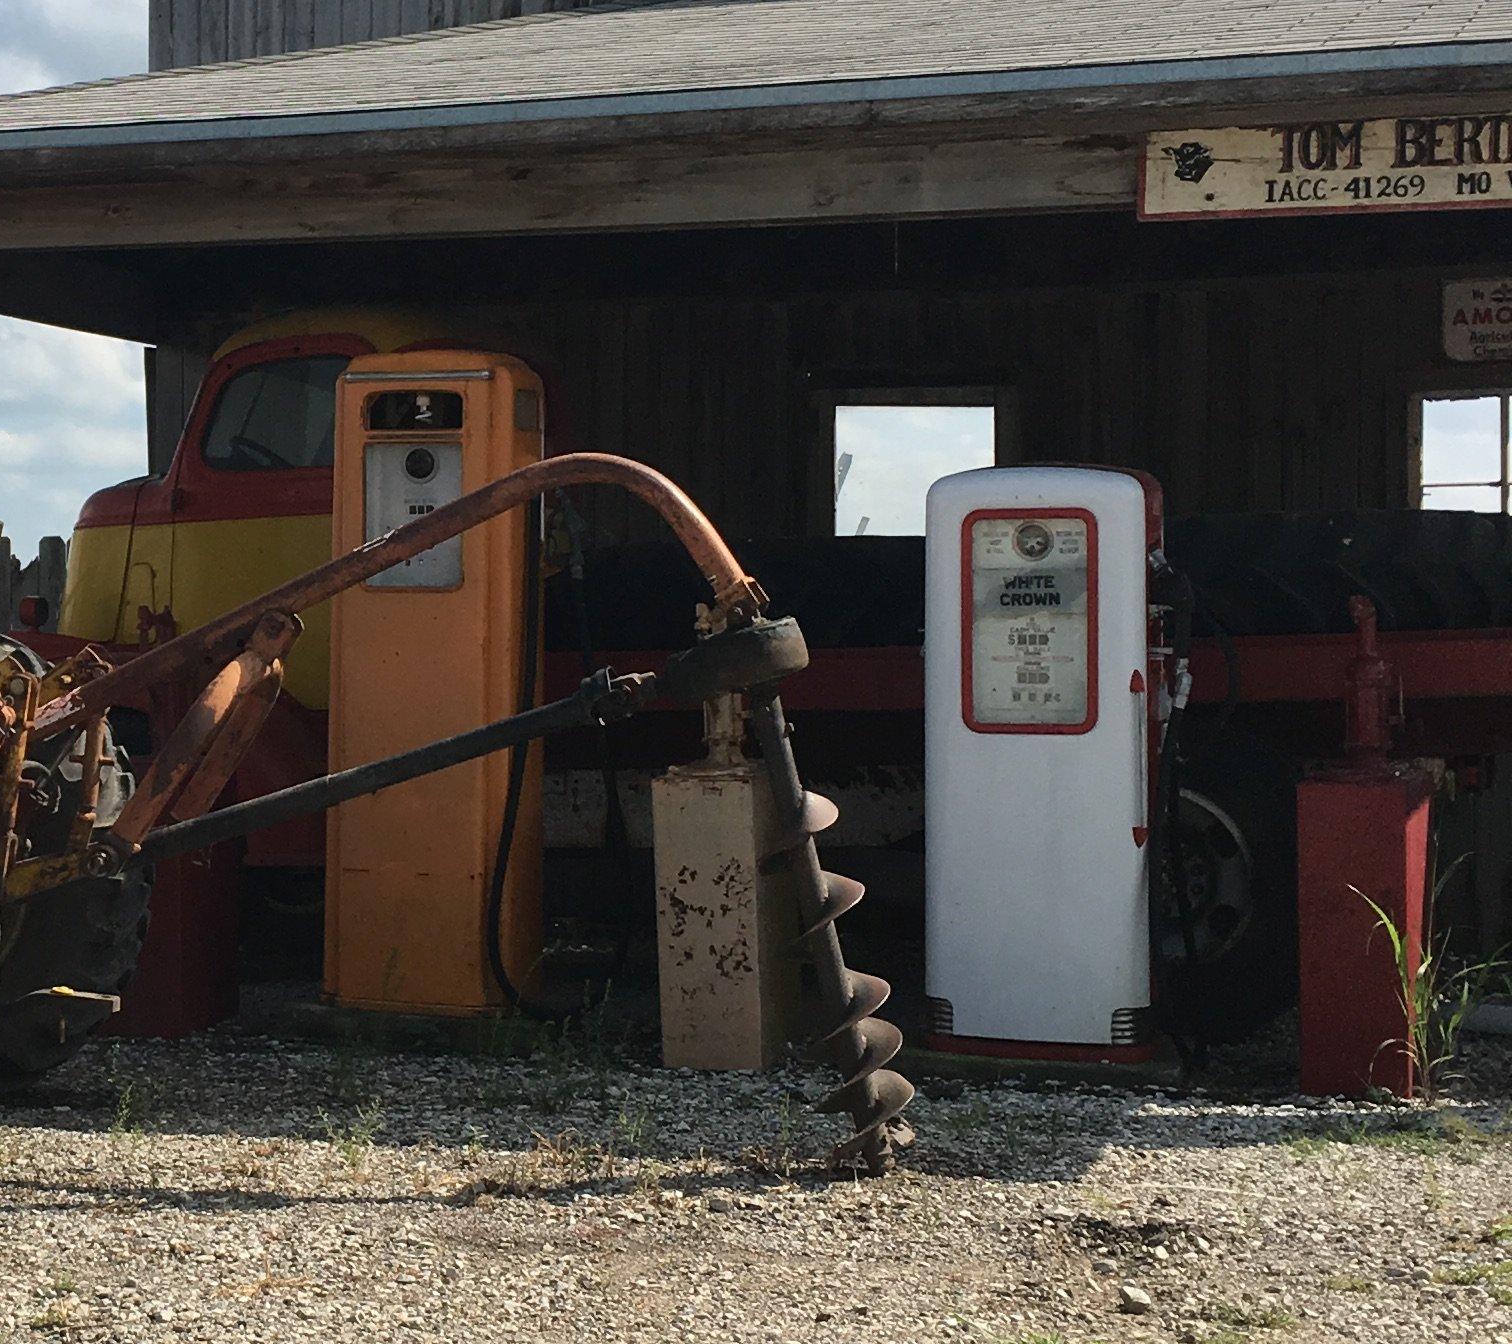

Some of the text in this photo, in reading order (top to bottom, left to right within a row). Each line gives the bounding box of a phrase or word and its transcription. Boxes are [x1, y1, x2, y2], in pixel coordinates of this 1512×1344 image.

[1271, 114, 1512, 173] TOM BERT
[1264, 174, 1426, 203] IACC-41269
[1456, 171, 1492, 196] MO
[1003, 575, 1056, 590] WHITE
[999, 592, 1061, 606] CROWN
